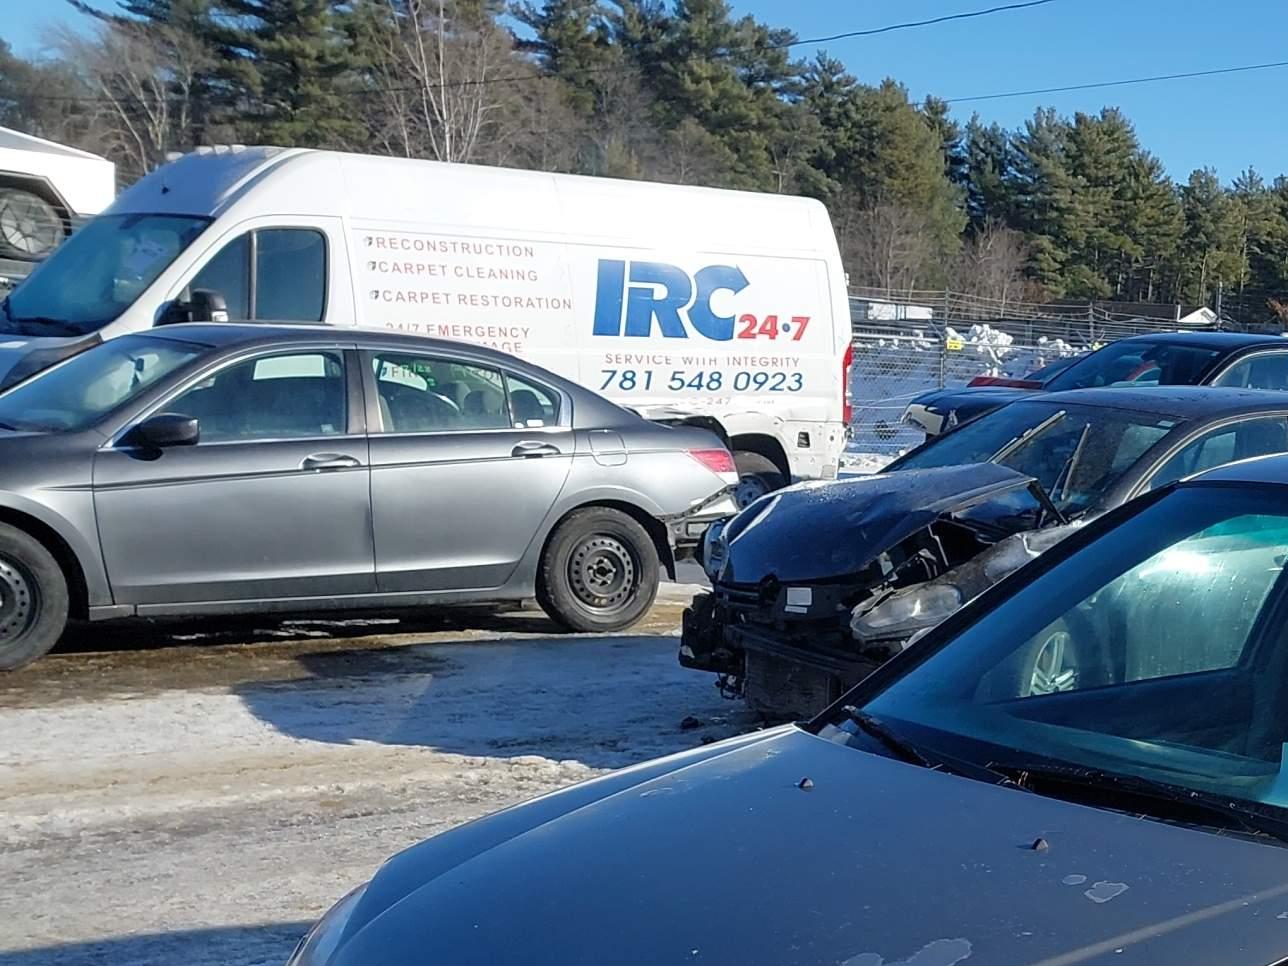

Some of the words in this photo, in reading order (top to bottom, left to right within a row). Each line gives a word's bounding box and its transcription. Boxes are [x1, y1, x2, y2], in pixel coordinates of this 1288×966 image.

[376, 237, 534, 257] RECONSTRUCTION
[378, 261, 448, 276] CARPET
[454, 265, 538, 281] CLEANING
[382, 290, 451, 305] CARPET
[457, 294, 572, 310] RESTORATION
[592, 258, 750, 342] IRC
[605, 354, 672, 365] SERVICE
[727, 356, 800, 368] INTEGRITY
[599, 369, 653, 391] 781
[668, 370, 723, 391] 548
[733, 371, 803, 392] 0923
